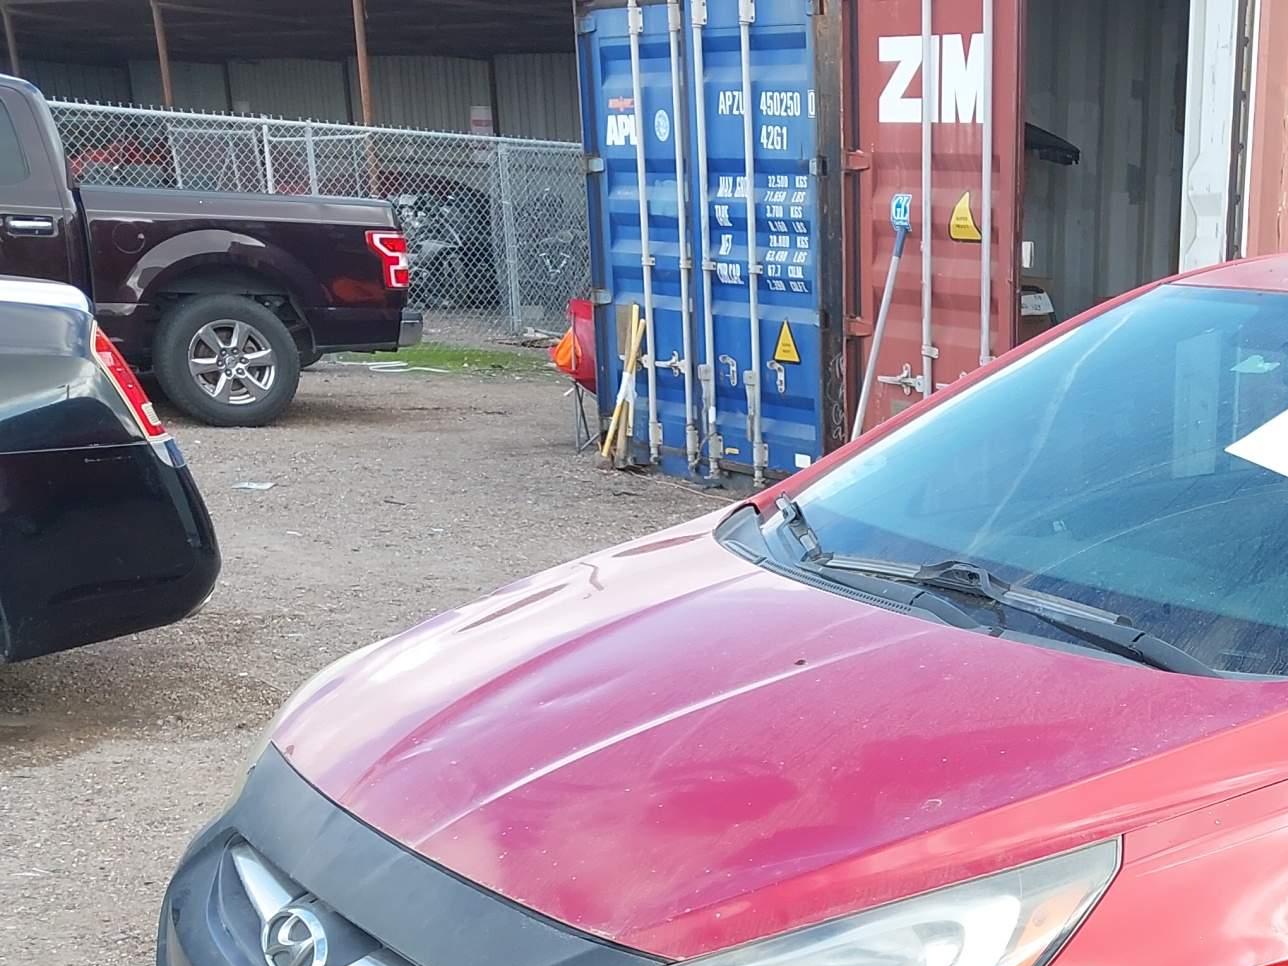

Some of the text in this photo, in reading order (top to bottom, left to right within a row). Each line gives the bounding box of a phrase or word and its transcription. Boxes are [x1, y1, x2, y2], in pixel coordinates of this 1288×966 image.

[878, 33, 985, 123] ZIM
[718, 91, 745, 115] APZU
[760, 91, 801, 117] 450250
[606, 114, 638, 146] APL
[760, 125, 788, 151] 42G1
